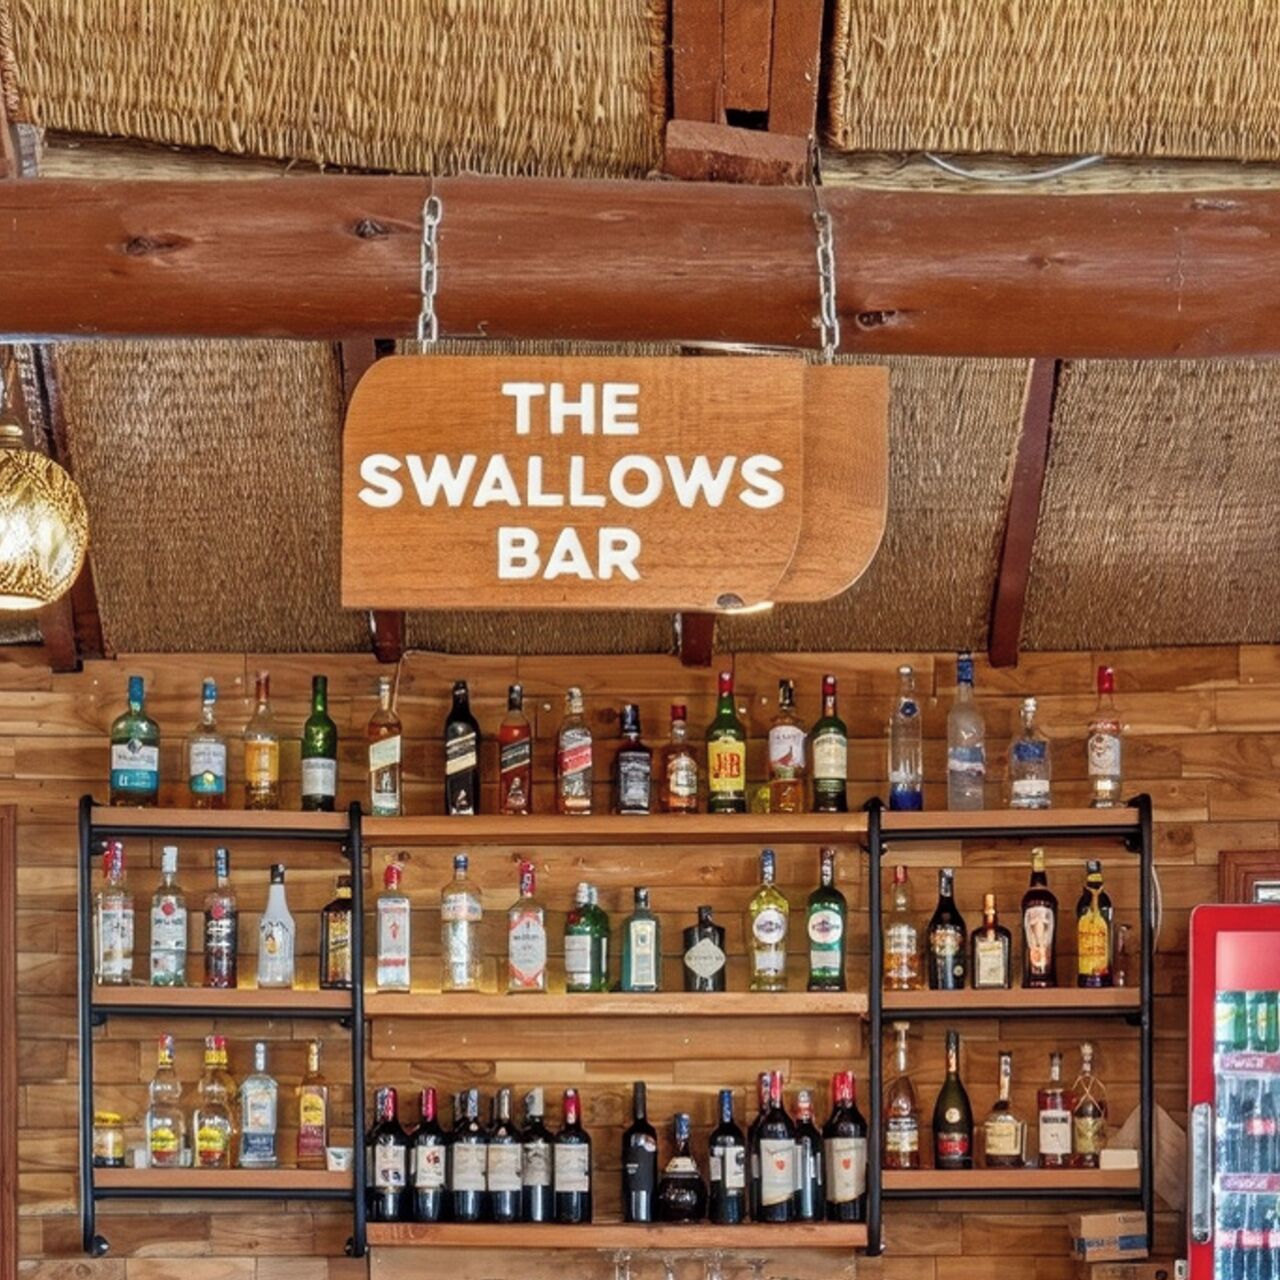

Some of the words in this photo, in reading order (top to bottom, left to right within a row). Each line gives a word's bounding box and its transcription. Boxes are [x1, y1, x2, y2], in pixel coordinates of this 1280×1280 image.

[502, 382, 640, 435] THE
[358, 454, 784, 508] SWALLOWS
[498, 527, 642, 581] BAR
